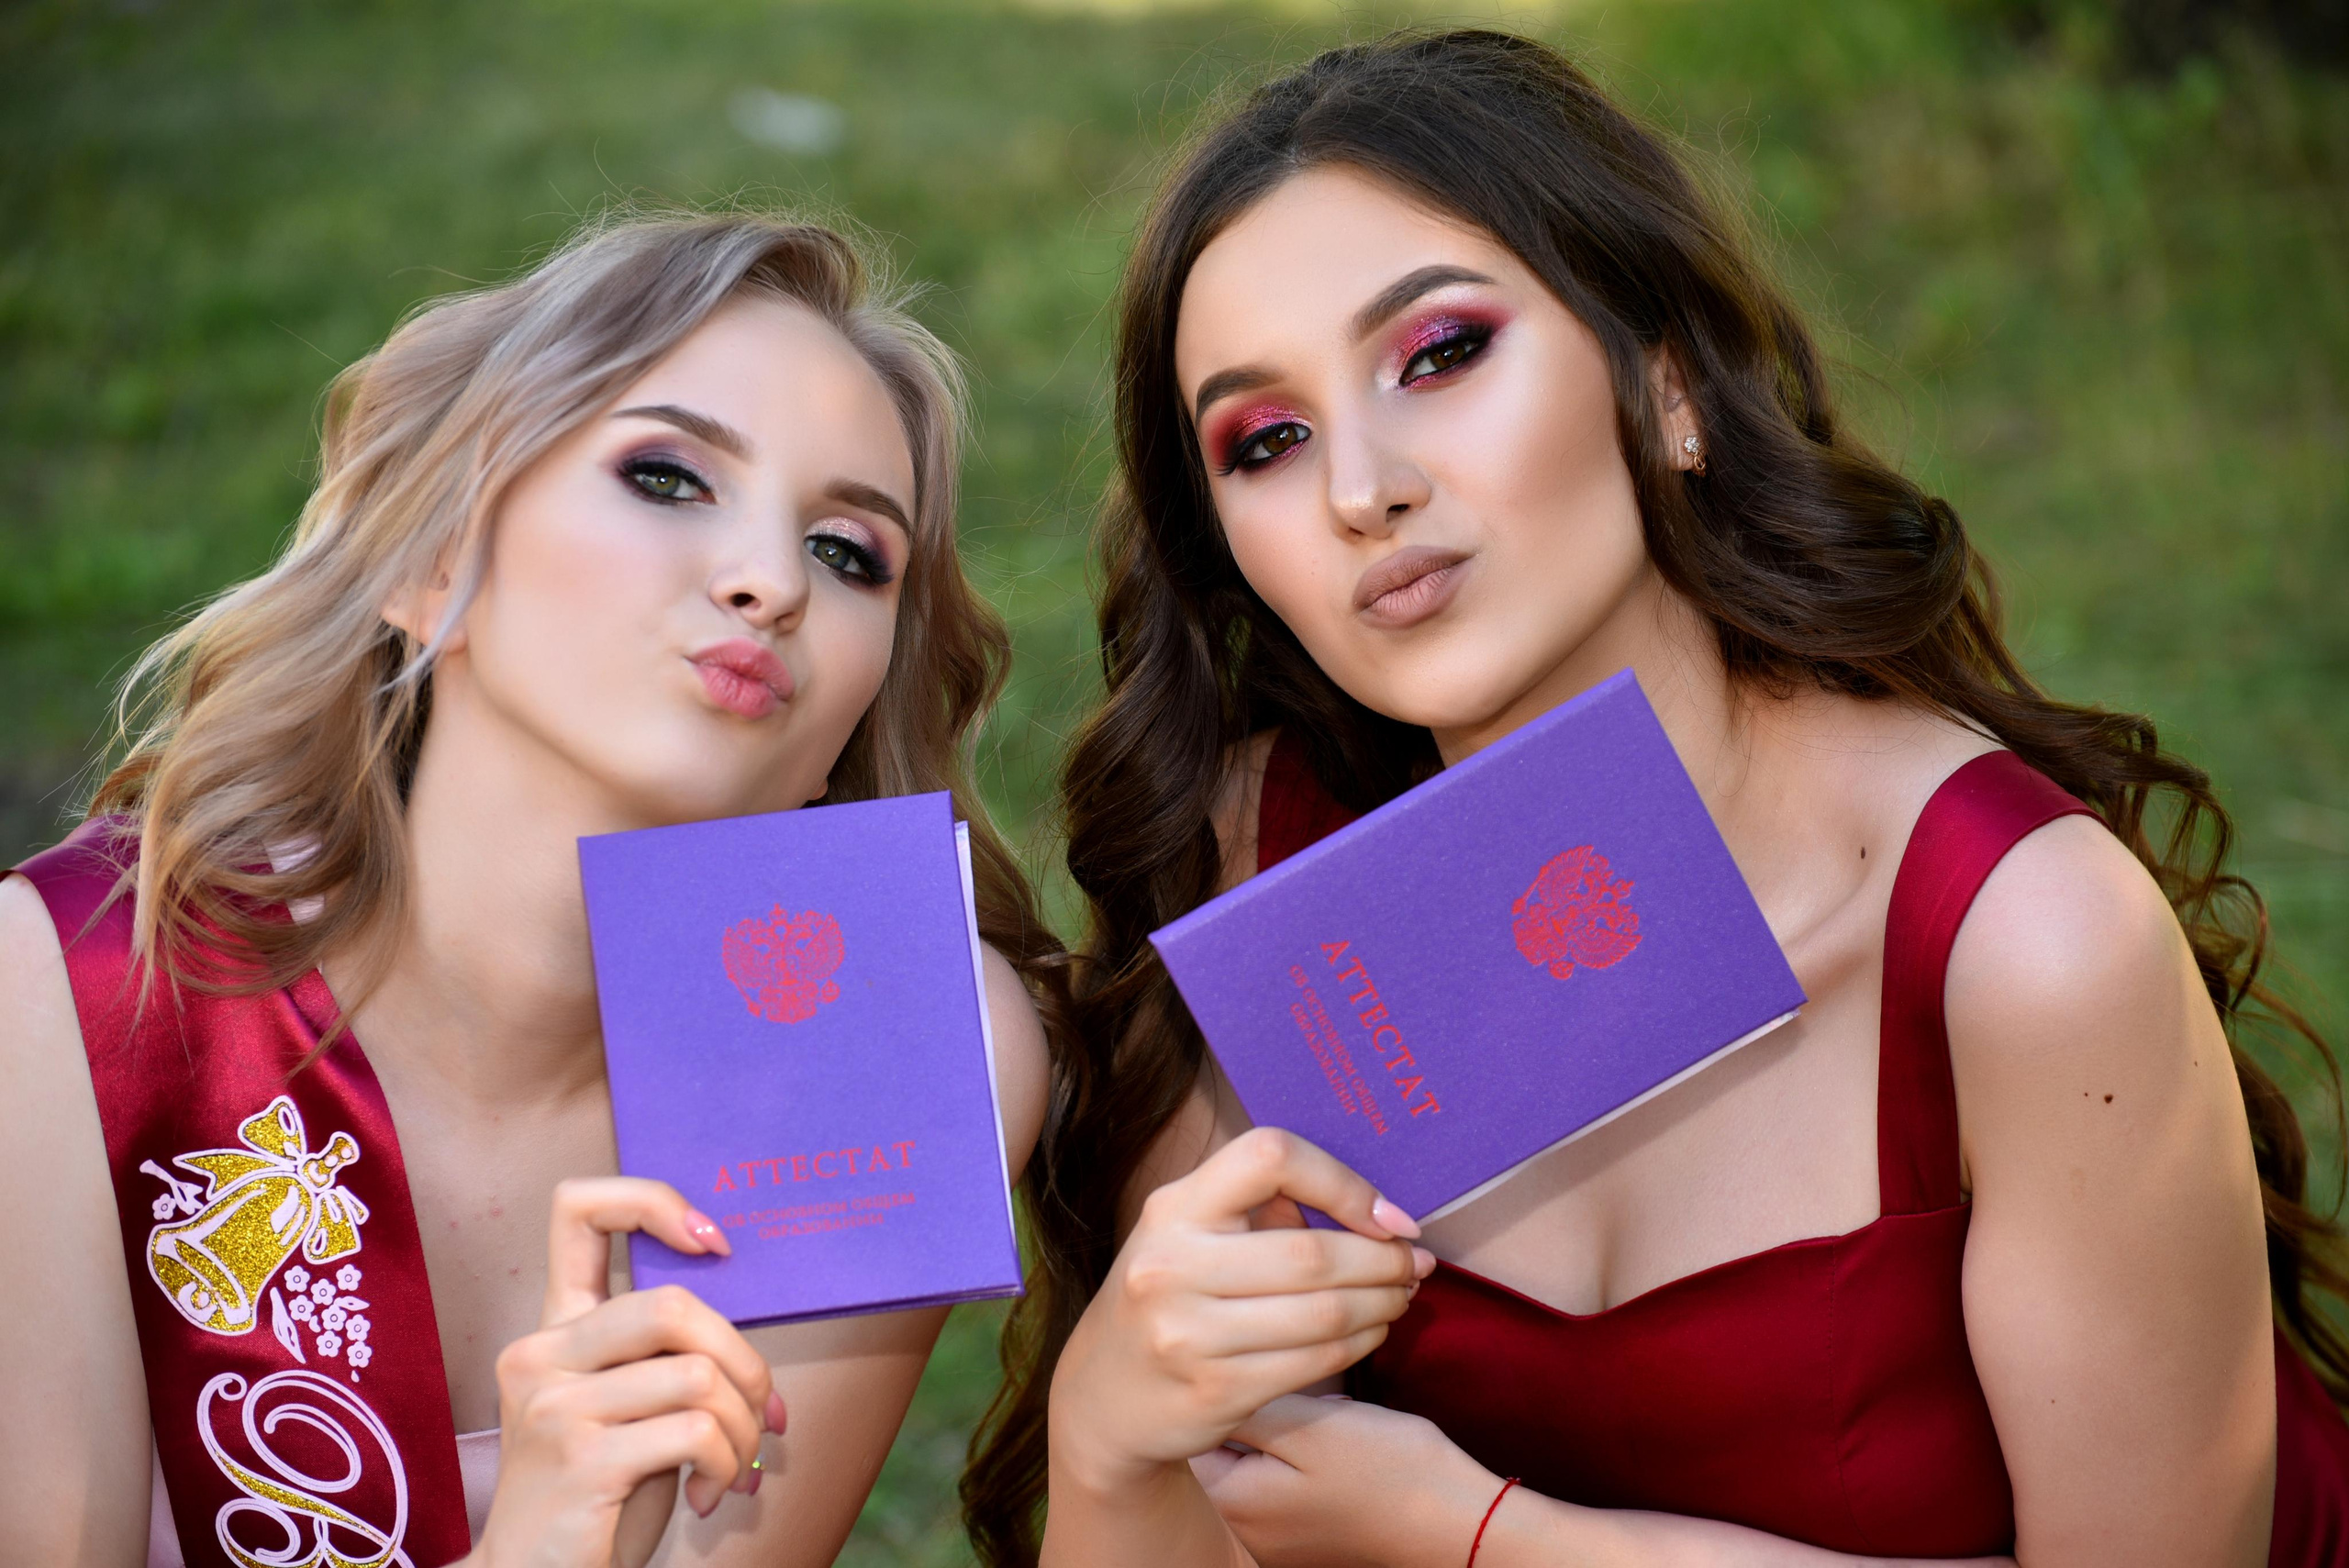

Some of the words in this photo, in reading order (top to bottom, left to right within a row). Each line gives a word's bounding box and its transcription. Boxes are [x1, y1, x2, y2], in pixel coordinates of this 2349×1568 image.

[1290, 965, 1308, 987] ОБ
[1302, 988, 1356, 1075] ОСНОВНОМ
[1352, 1078, 1388, 1136] ОБЩЕМ
[1290, 1004, 1356, 1114] ОБРАЗОВАНИИ
[1320, 940, 1441, 1118] АТТЕСТАТ
[714, 1140, 916, 1192] АТТЕСТАТ
[721, 1213, 746, 1229] ОБ
